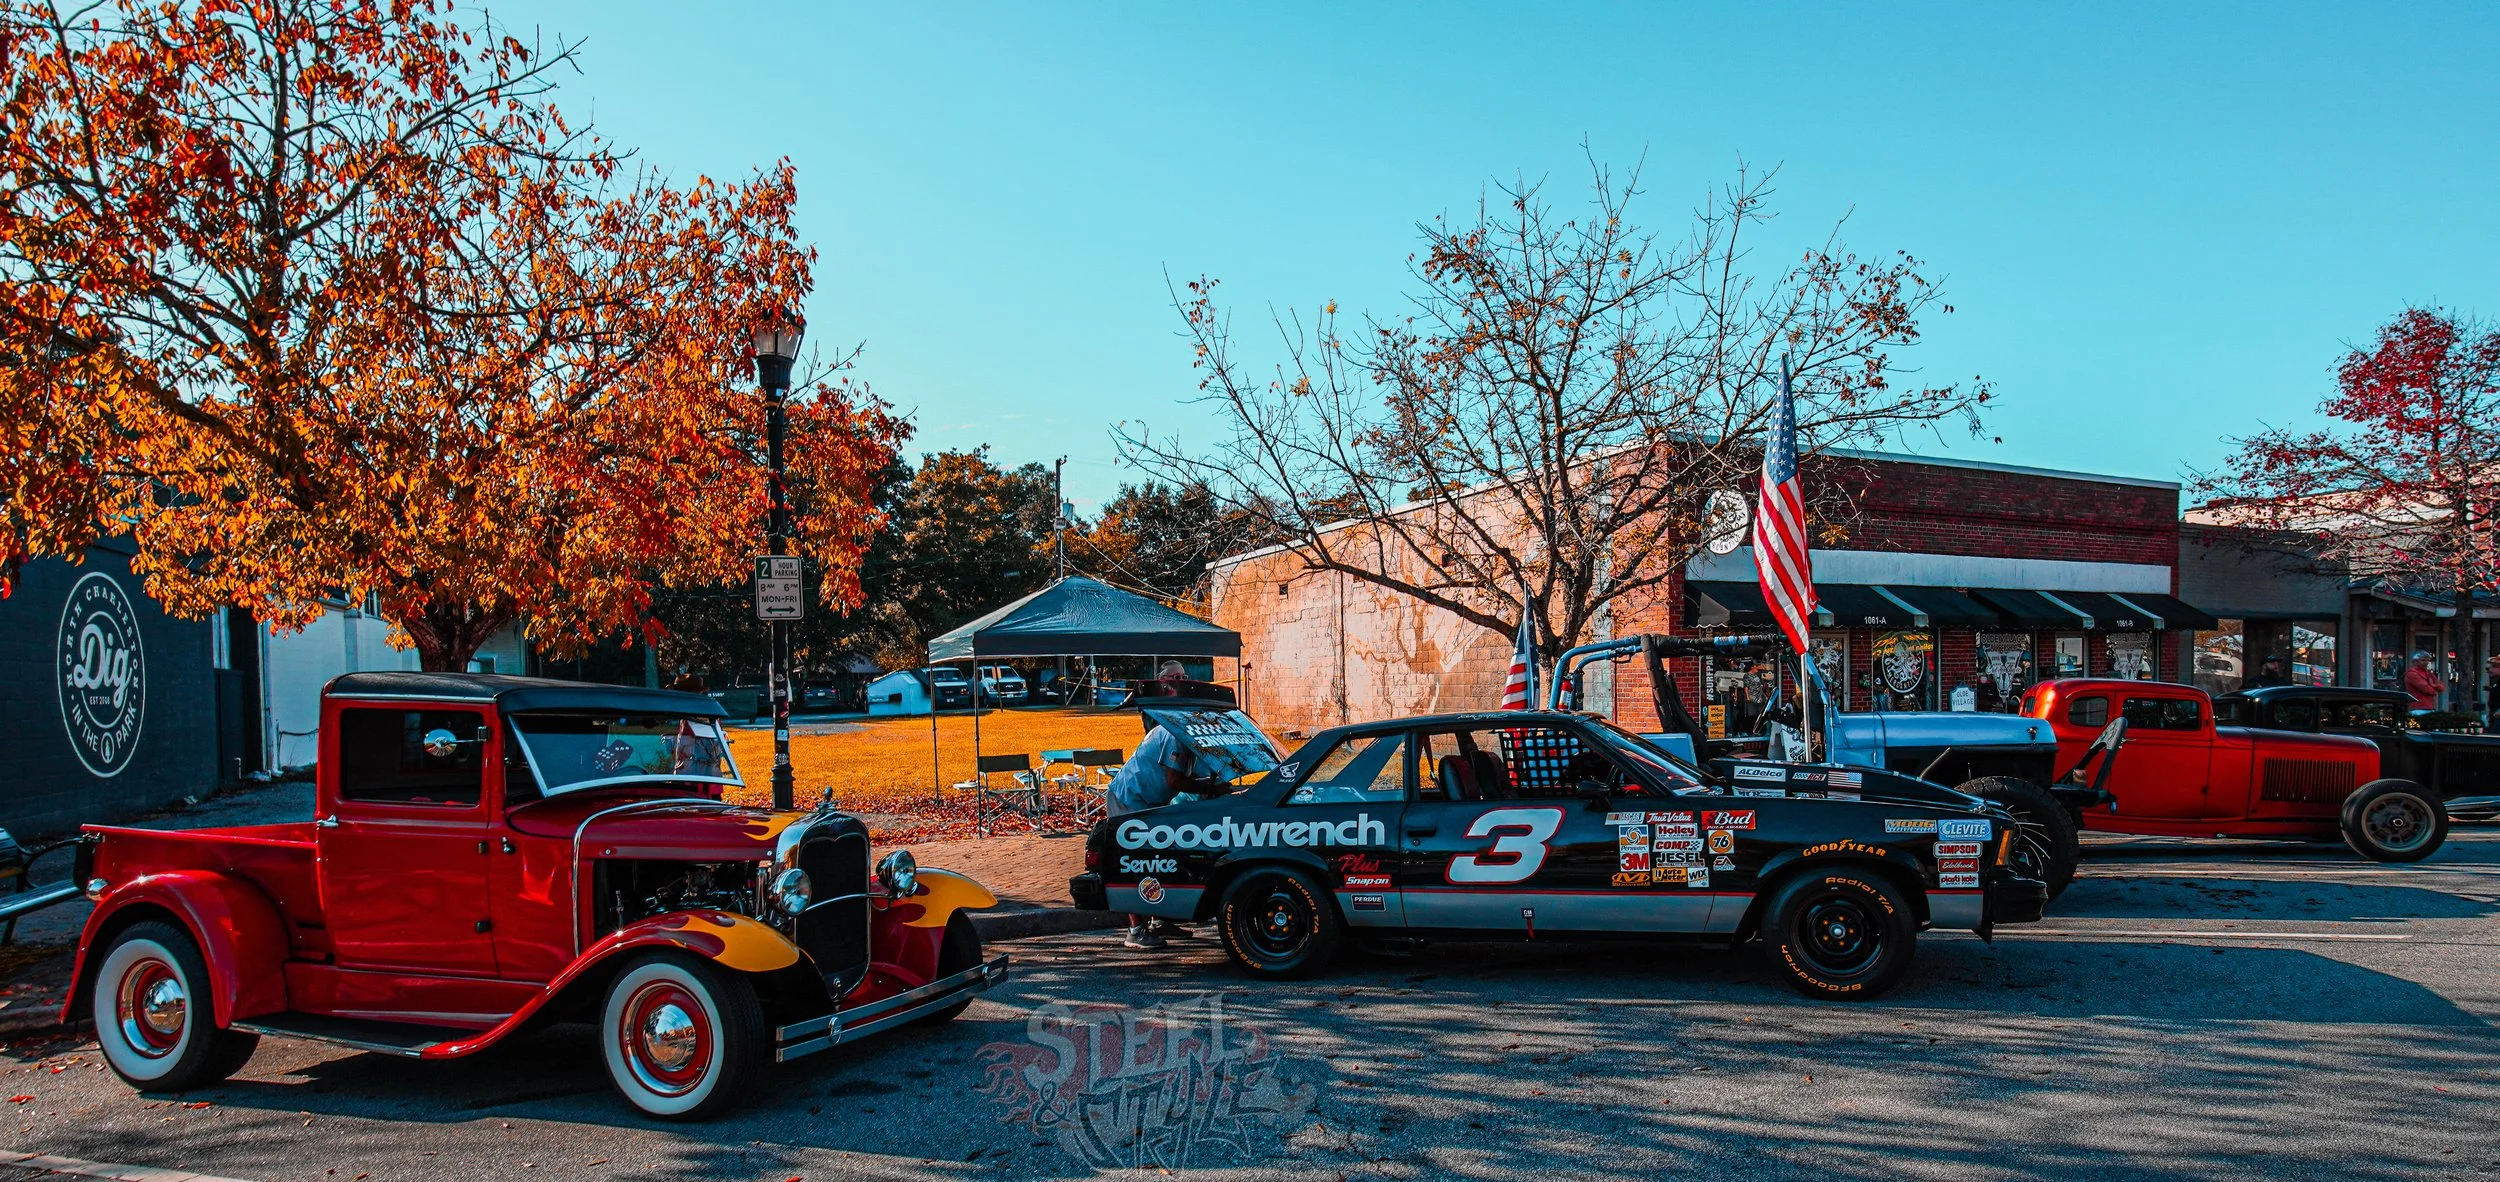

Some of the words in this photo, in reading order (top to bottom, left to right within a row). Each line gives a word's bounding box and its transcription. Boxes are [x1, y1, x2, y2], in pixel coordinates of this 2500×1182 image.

[761, 561, 769, 577] 2
[1864, 616, 1887, 625] 1061-A
[65, 601, 82, 688] NORTH
[86, 585, 140, 689] CHARLESTON
[73, 623, 133, 709] Dig
[72, 703, 84, 727] IN
[82, 721, 99, 752] THE
[115, 701, 137, 749] PARK
[1737, 768, 1783, 778] ACDelco
[1714, 811, 1752, 825] Bud
[1116, 813, 1385, 850] Goodwrench
[1658, 825, 1695, 836] Holley
[1942, 821, 1987, 835] CLEVITE
[1444, 806, 1566, 885] 3
[1655, 840, 1691, 850] COMP
[1713, 835, 1731, 849] 76
[1802, 839, 1887, 857] GOODYEAR
[1938, 845, 1978, 855] SIMPSON
[1120, 854, 1178, 873] Service
[1338, 853, 1381, 873] Plus
[1621, 853, 1650, 870] 3M
[1656, 852, 1704, 863] JESEL
[1714, 857, 1733, 866] EA
[1942, 861, 1975, 869] Edelbrock
[1346, 876, 1390, 887] Snap-on
[1688, 868, 1707, 880] WIX
[1287, 877, 1317, 911] Radial
[1825, 876, 1877, 895] Radial
[1876, 894, 1895, 915] T/A
[1225, 904, 1262, 969] BFGoodrich
[1780, 943, 1862, 992] BFGoodrich
